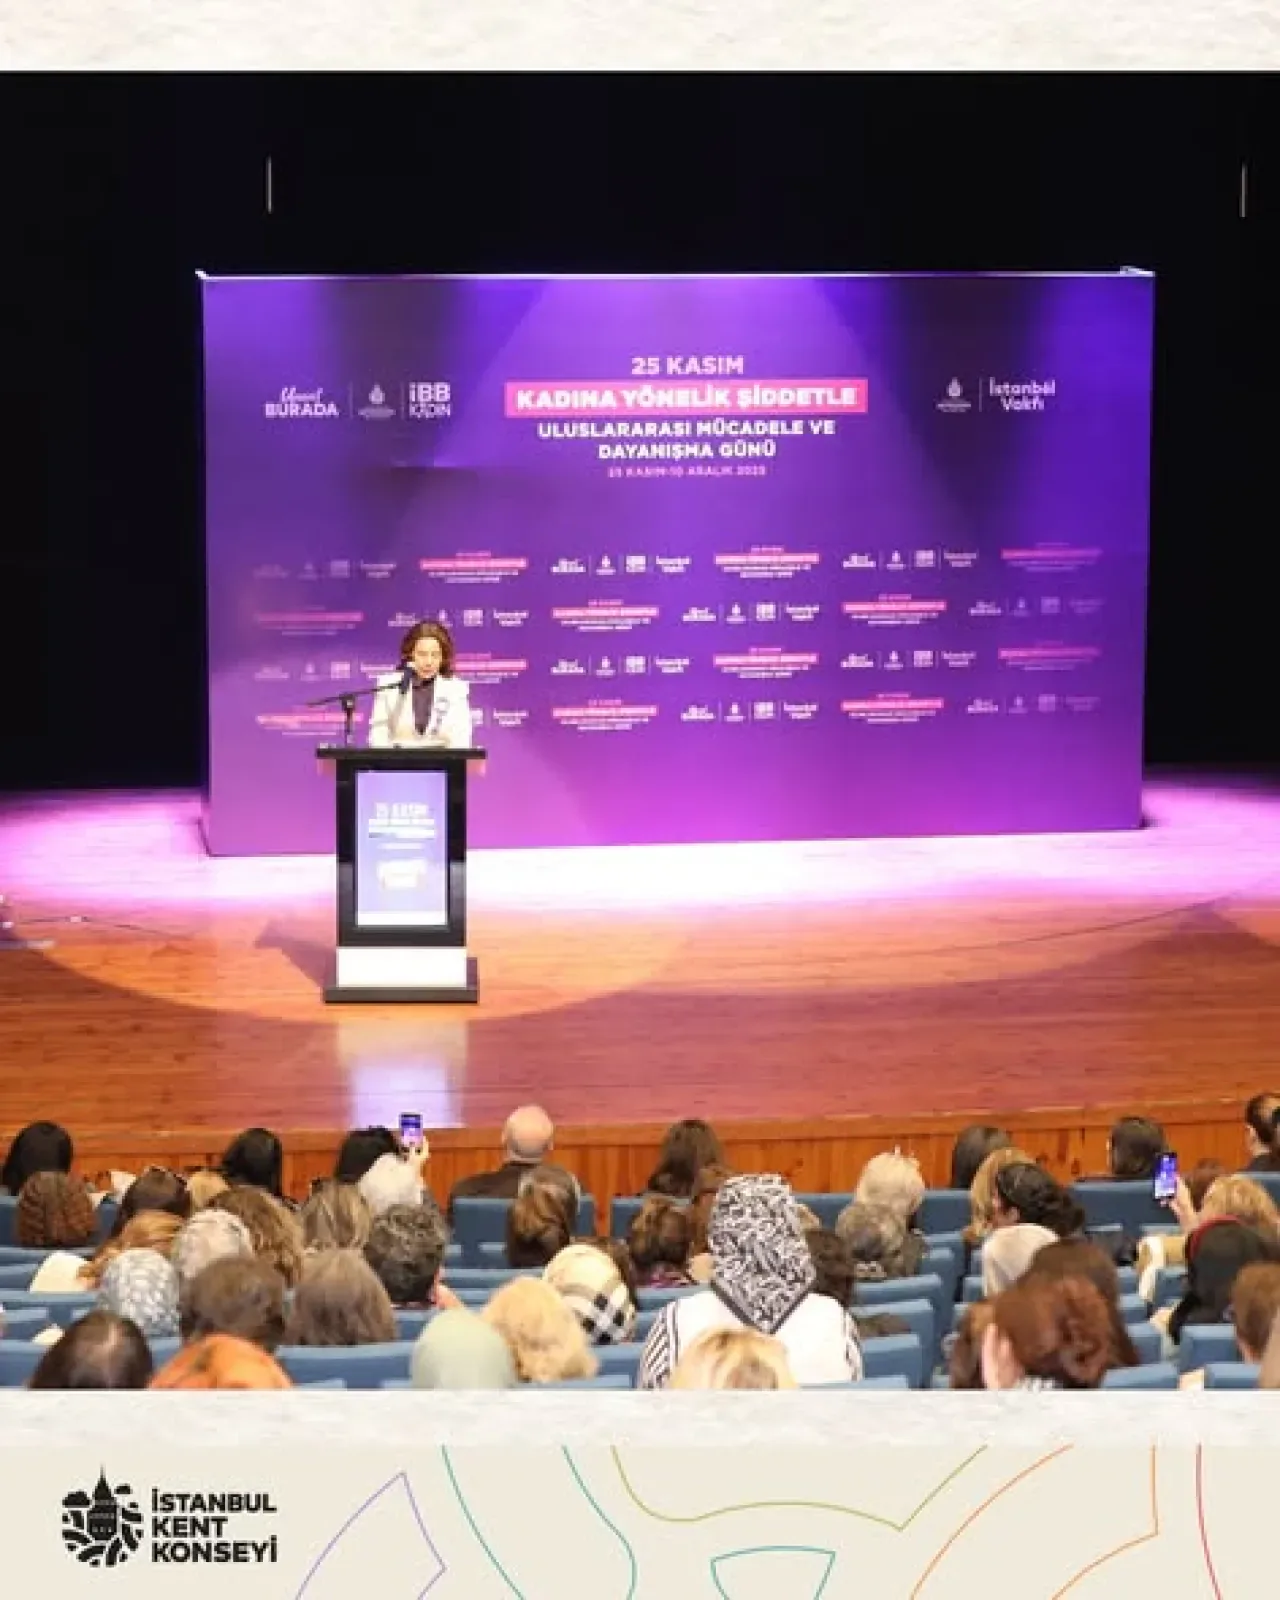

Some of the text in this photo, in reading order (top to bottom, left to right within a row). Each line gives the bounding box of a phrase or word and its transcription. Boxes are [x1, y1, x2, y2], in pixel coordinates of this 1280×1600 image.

[631, 355, 744, 375] 25 KASIM
[516, 384, 857, 410] KADINA YÖNELİK ŞİDDETLE
[538, 417, 836, 438] ULUSLARARASI MÜCADELE VE
[598, 439, 777, 461] DAYANIŞMA GÜNÜ
